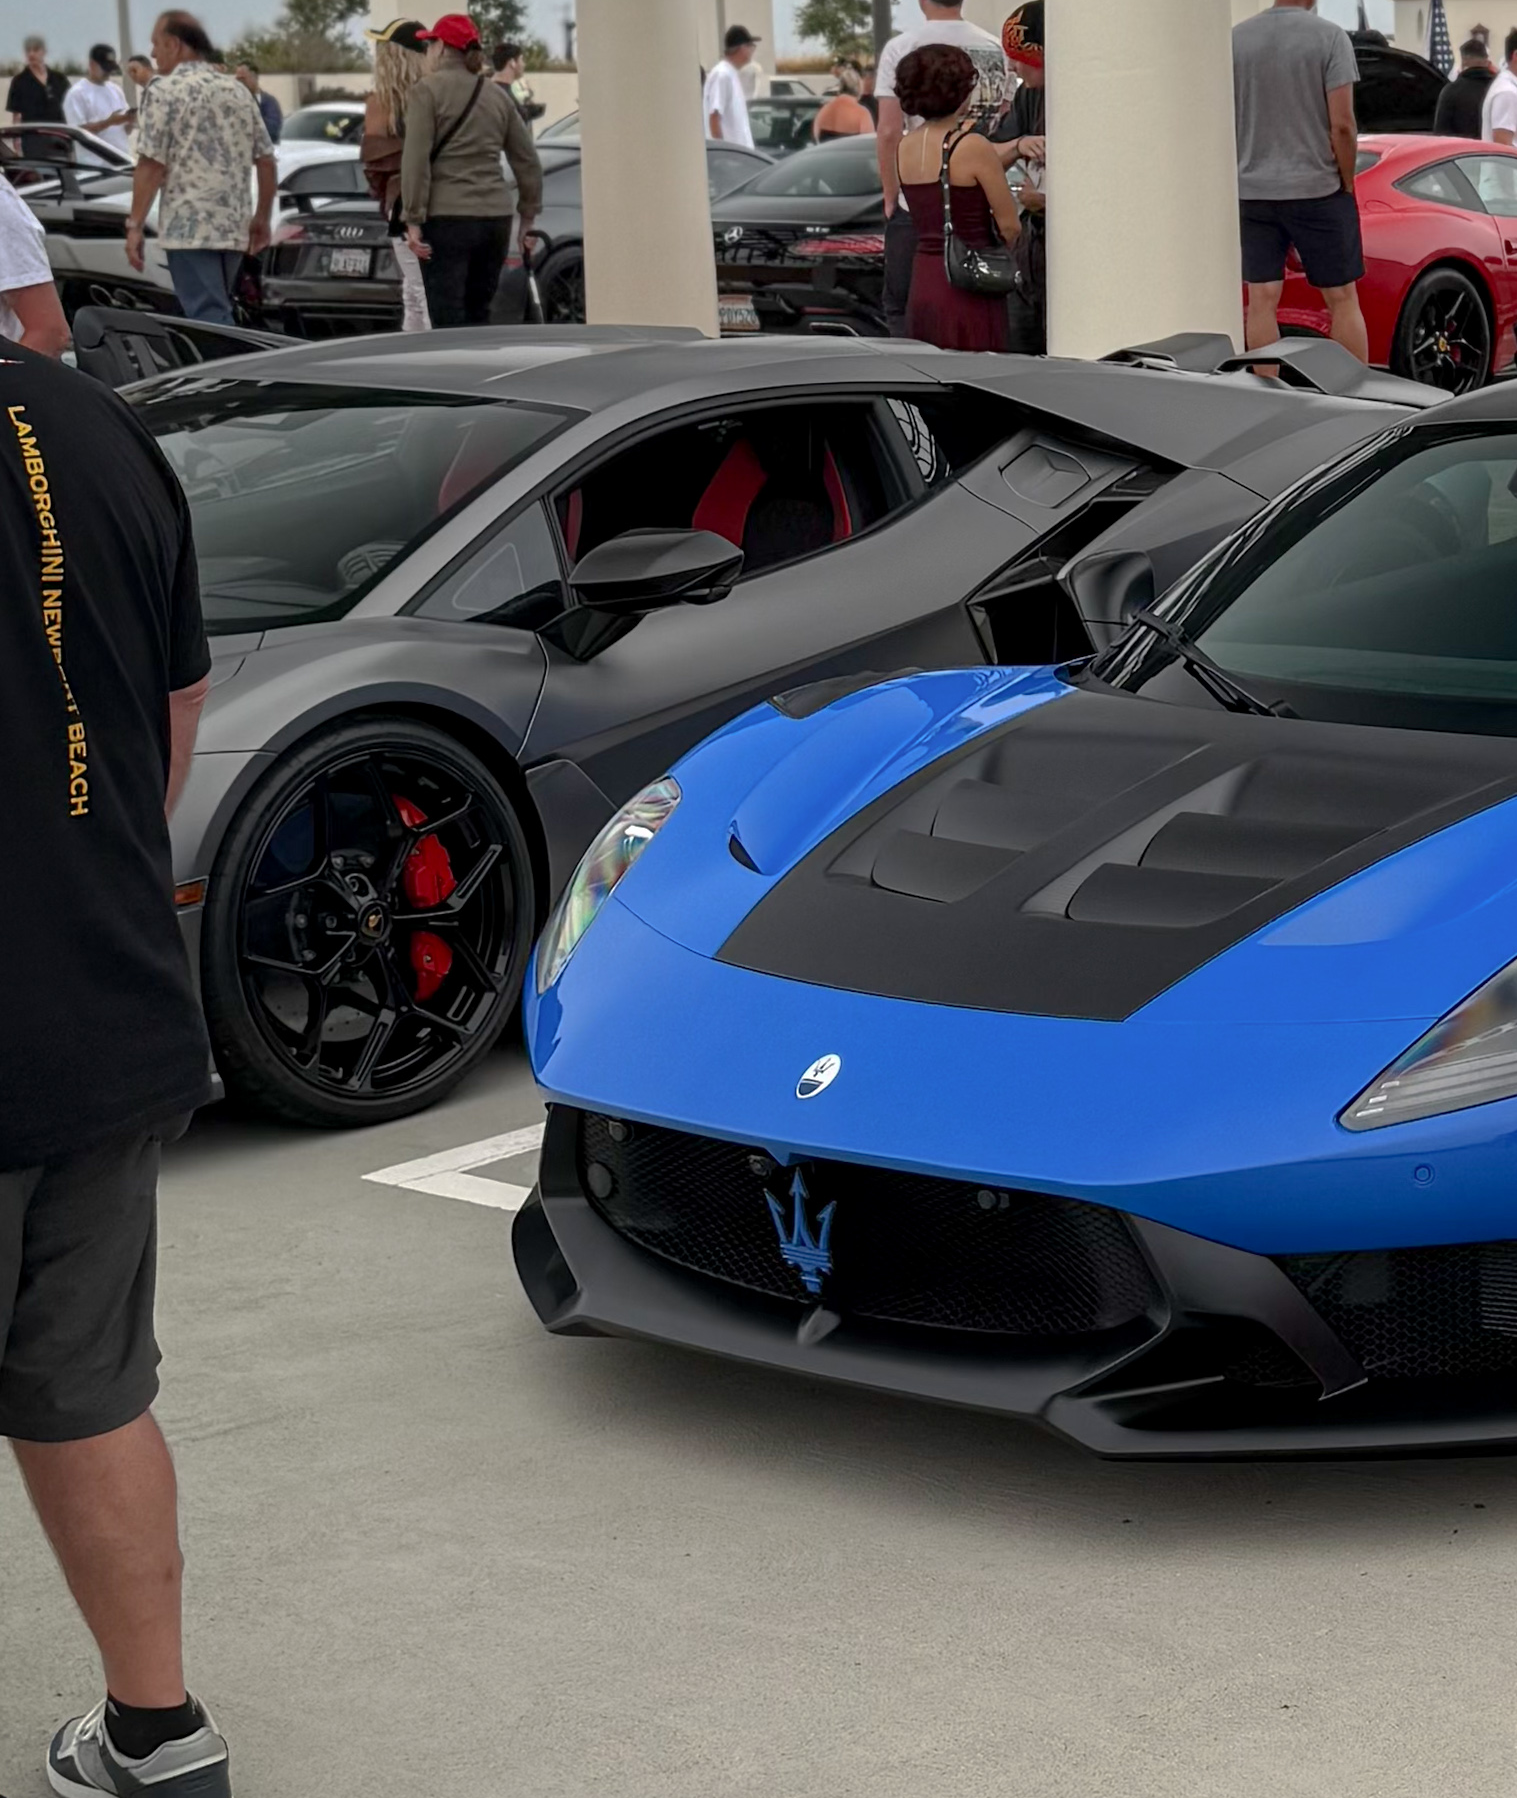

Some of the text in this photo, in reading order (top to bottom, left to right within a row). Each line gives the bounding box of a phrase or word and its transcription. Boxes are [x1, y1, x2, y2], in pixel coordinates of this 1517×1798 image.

[8, 406, 89, 816] LAMBORGHINI NEWPT BEACH
